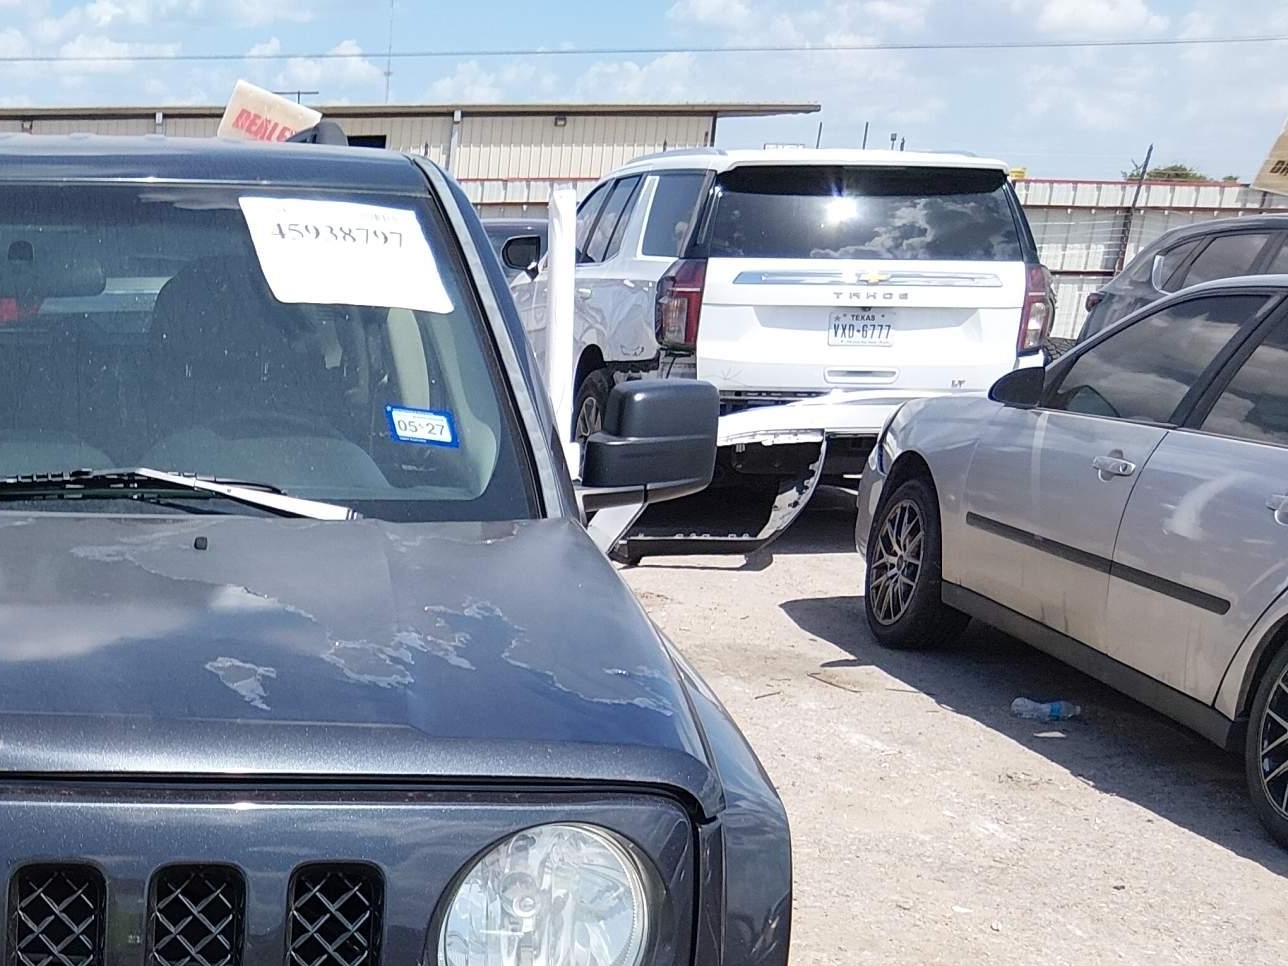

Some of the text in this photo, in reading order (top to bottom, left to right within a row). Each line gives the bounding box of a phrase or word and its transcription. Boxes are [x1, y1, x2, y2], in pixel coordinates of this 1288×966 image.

[232, 108, 296, 142] DEALE
[271, 223, 402, 248] 45938797
[833, 291, 909, 300] TAHOE
